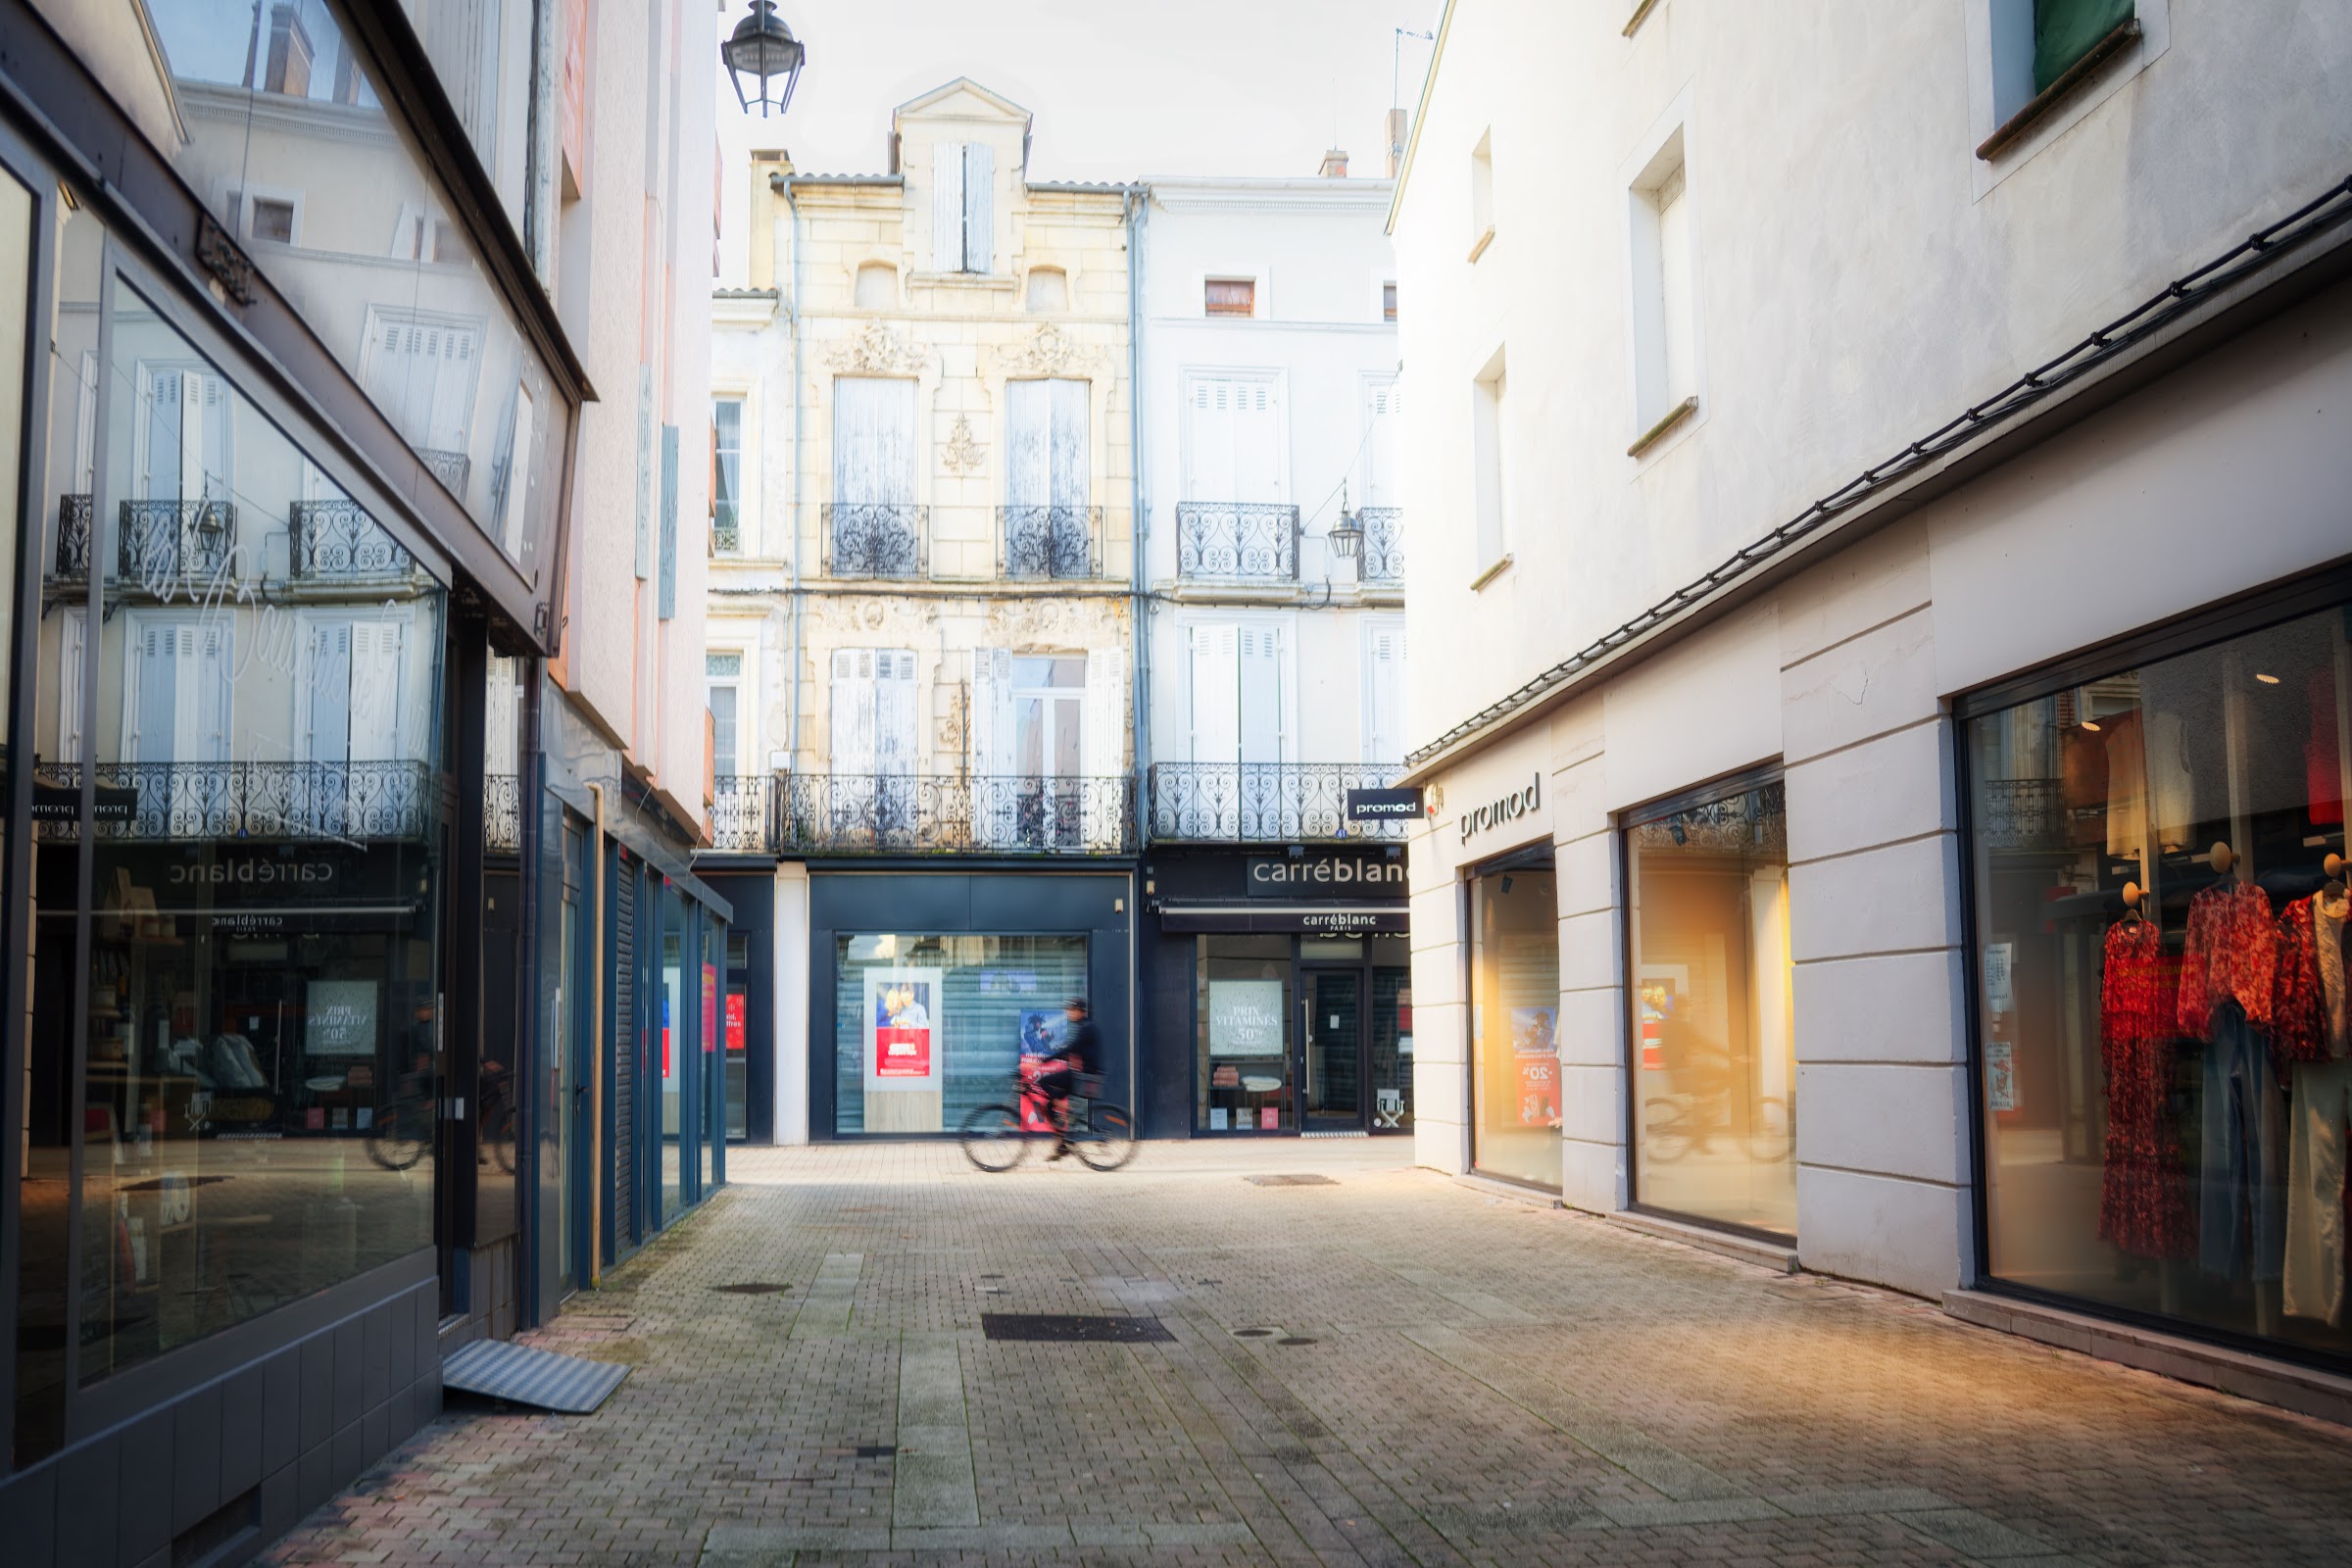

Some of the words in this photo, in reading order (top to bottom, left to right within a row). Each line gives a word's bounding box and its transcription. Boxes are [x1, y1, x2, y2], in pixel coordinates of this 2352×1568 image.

[1356, 802, 1416, 814] promod
[1460, 771, 1541, 848] promod
[1253, 858, 1409, 882] carréblan
[1302, 912, 1376, 925] carréblanc
[1234, 1006, 1259, 1015] PRIX
[1215, 1013, 1278, 1025] VITAMINÉS
